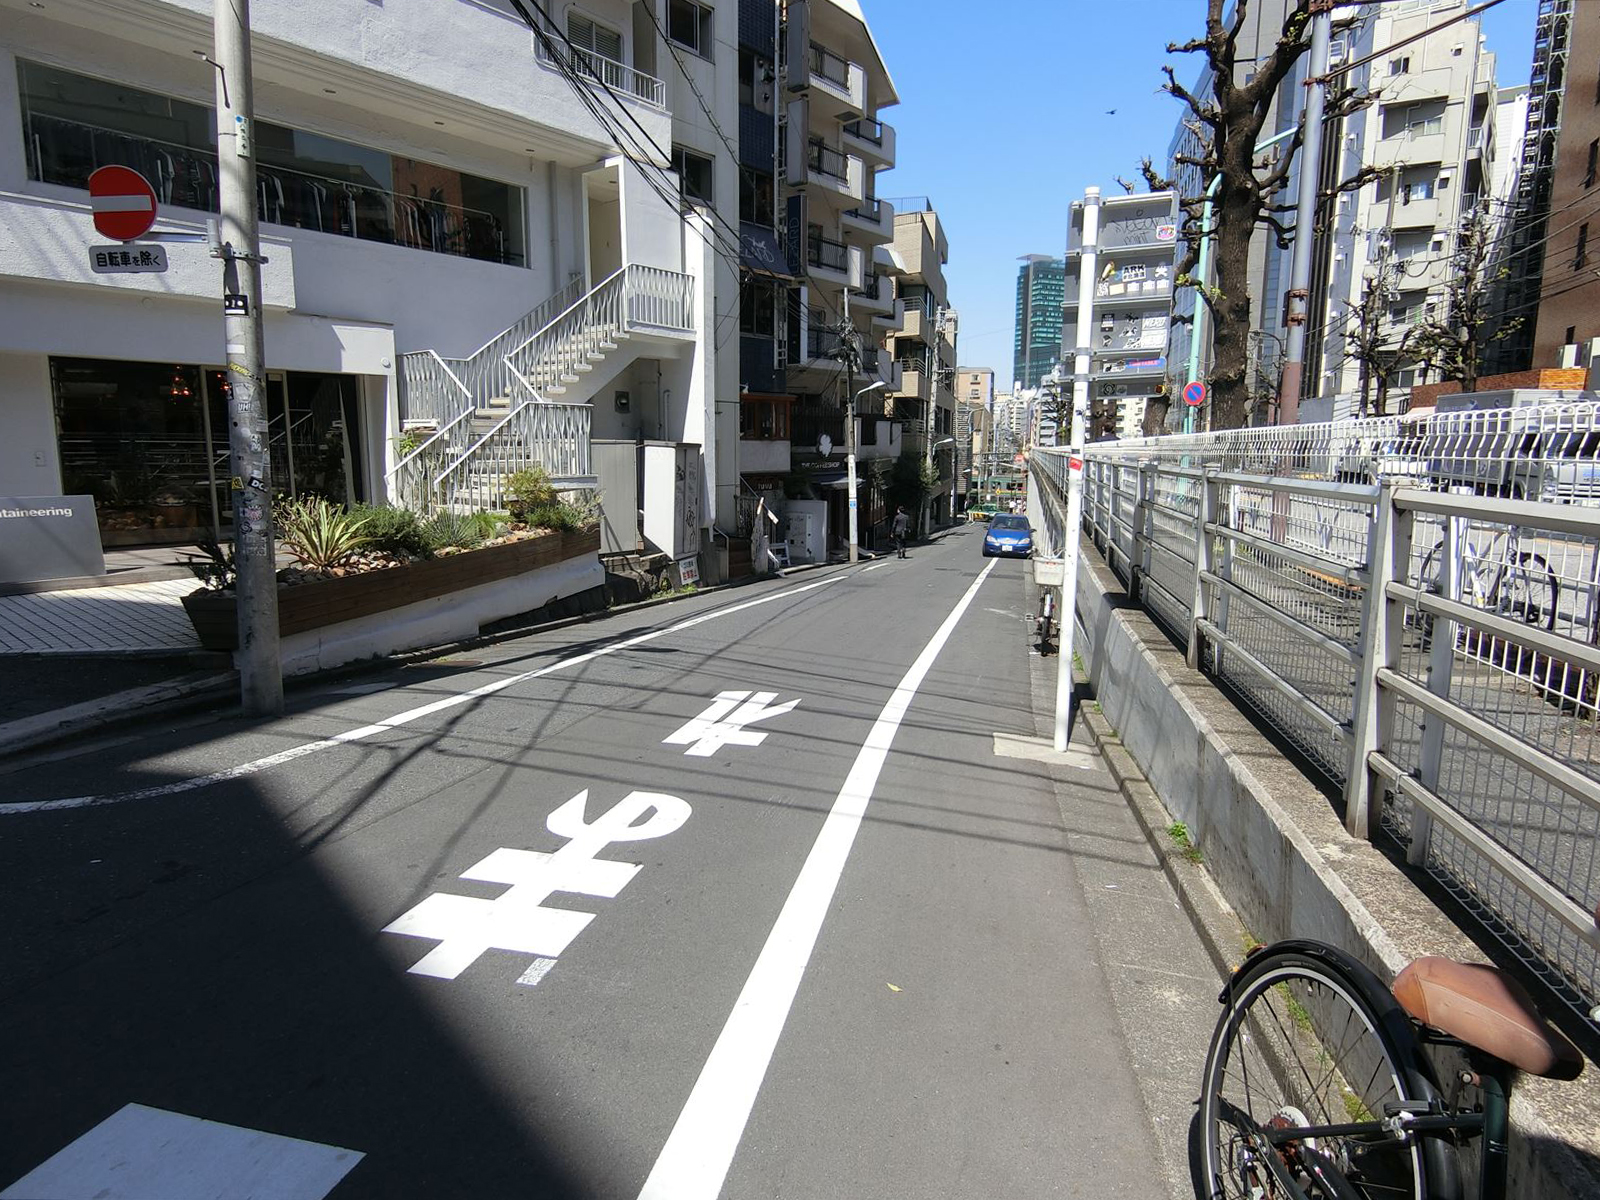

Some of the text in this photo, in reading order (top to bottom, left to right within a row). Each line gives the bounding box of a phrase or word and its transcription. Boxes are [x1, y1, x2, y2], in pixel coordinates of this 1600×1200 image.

[96, 250, 161, 267] 自転車を除く
[1123, 264, 1145, 275] ARK
